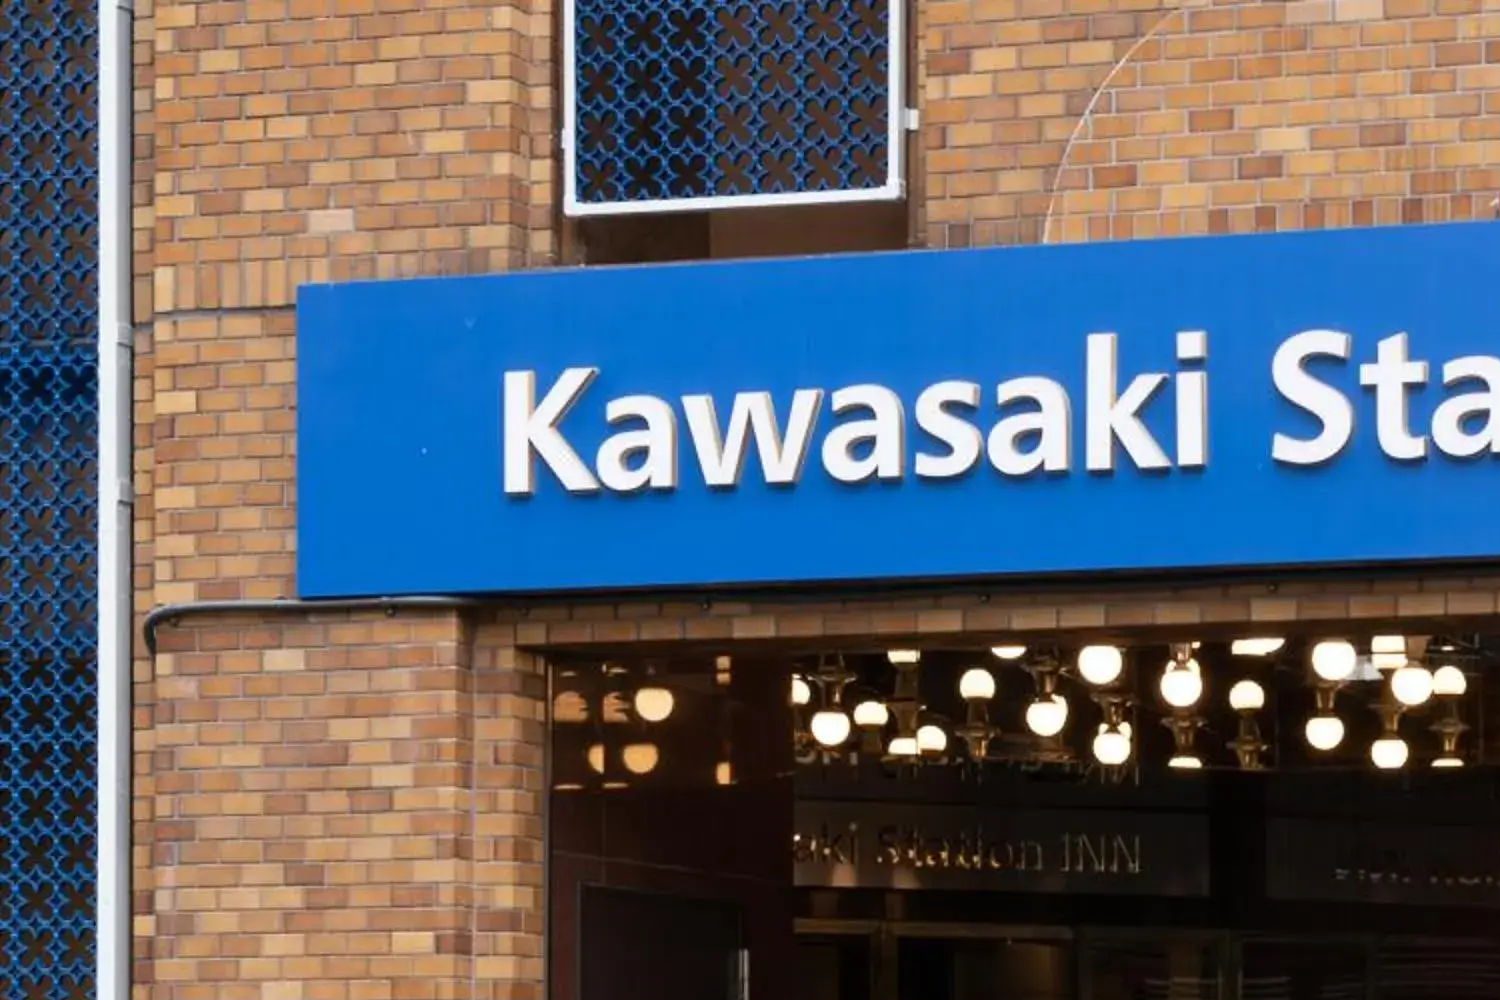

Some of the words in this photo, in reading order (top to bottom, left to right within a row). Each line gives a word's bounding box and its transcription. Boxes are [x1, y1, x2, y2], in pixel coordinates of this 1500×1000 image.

[502, 329, 1209, 496] Kawasaki
[876, 822, 1044, 872] Station
[1059, 832, 1145, 875] INN
